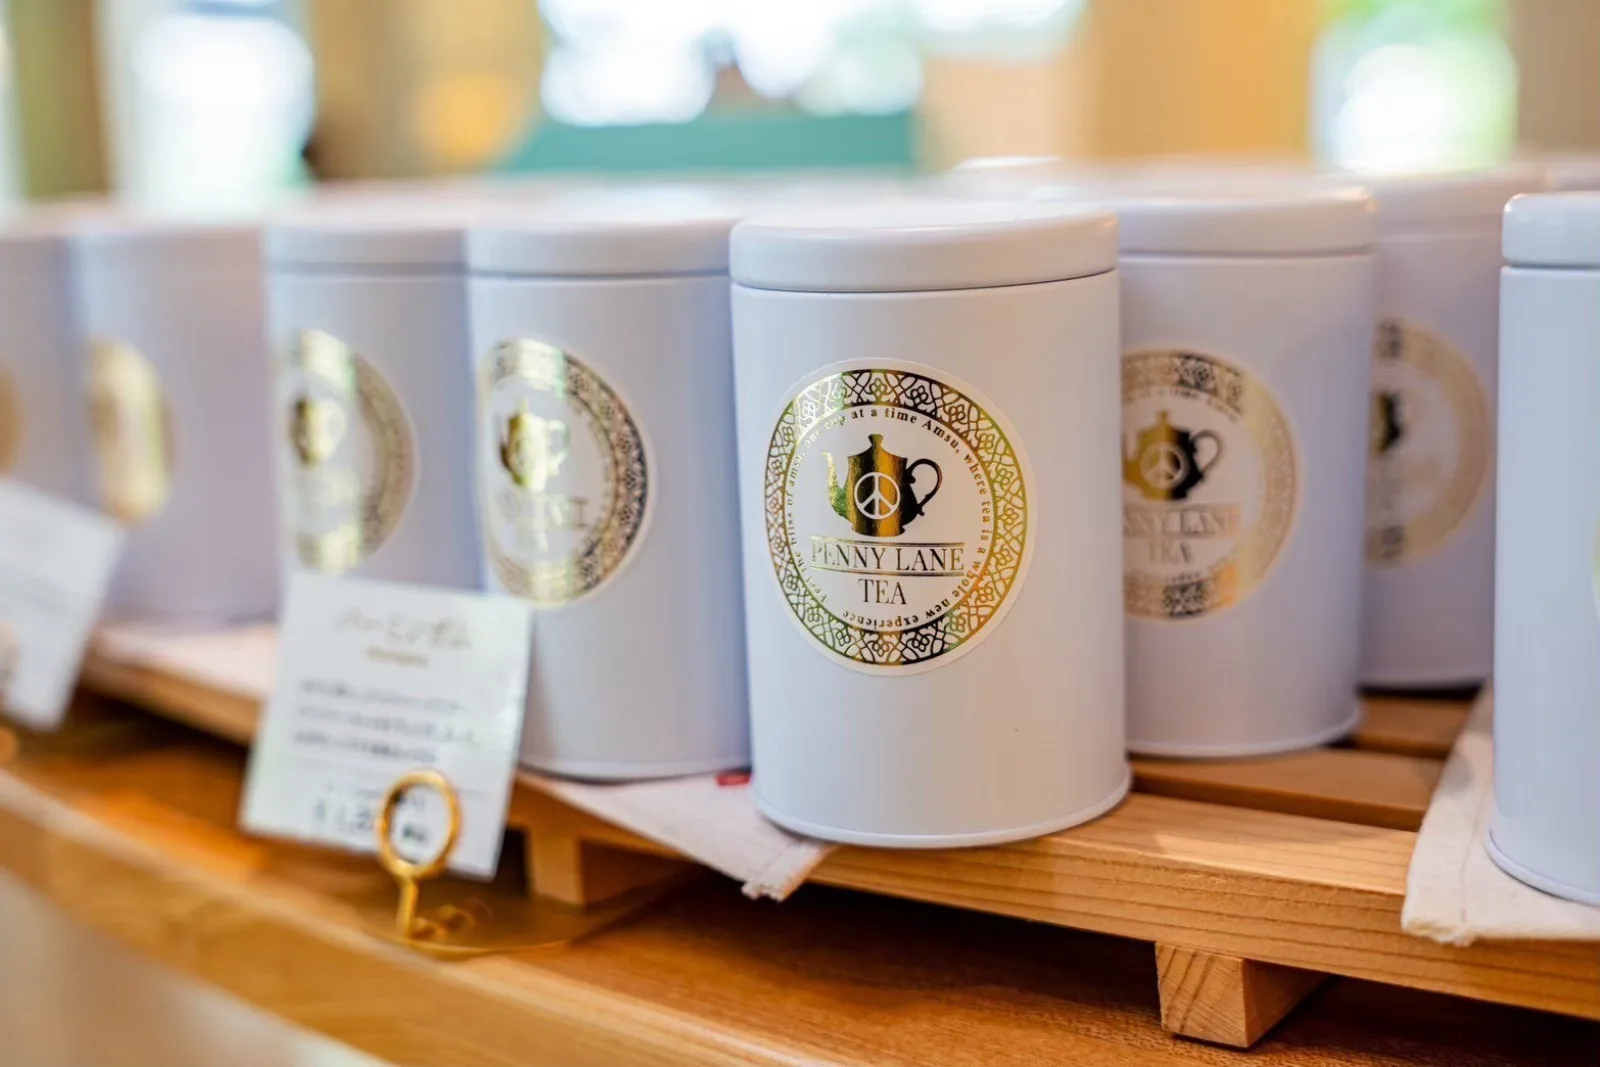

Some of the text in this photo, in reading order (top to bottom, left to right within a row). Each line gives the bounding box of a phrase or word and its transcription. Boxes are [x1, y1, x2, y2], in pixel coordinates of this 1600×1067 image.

[824, 415, 846, 430] cup
[851, 408, 865, 420] at
[870, 408, 878, 418] a
[884, 407, 918, 424] time
[804, 427, 823, 448] one
[921, 419, 960, 454] Amsu,
[963, 453, 988, 496] where
[786, 491, 794, 506] of
[980, 501, 991, 523] tea
[980, 529, 993, 541] is
[794, 551, 807, 573] the
[811, 540, 965, 572] PENNY LANE
[951, 560, 982, 598] whole
[858, 578, 908, 605] TEA
[925, 598, 950, 619] new
[842, 609, 920, 630] experience
